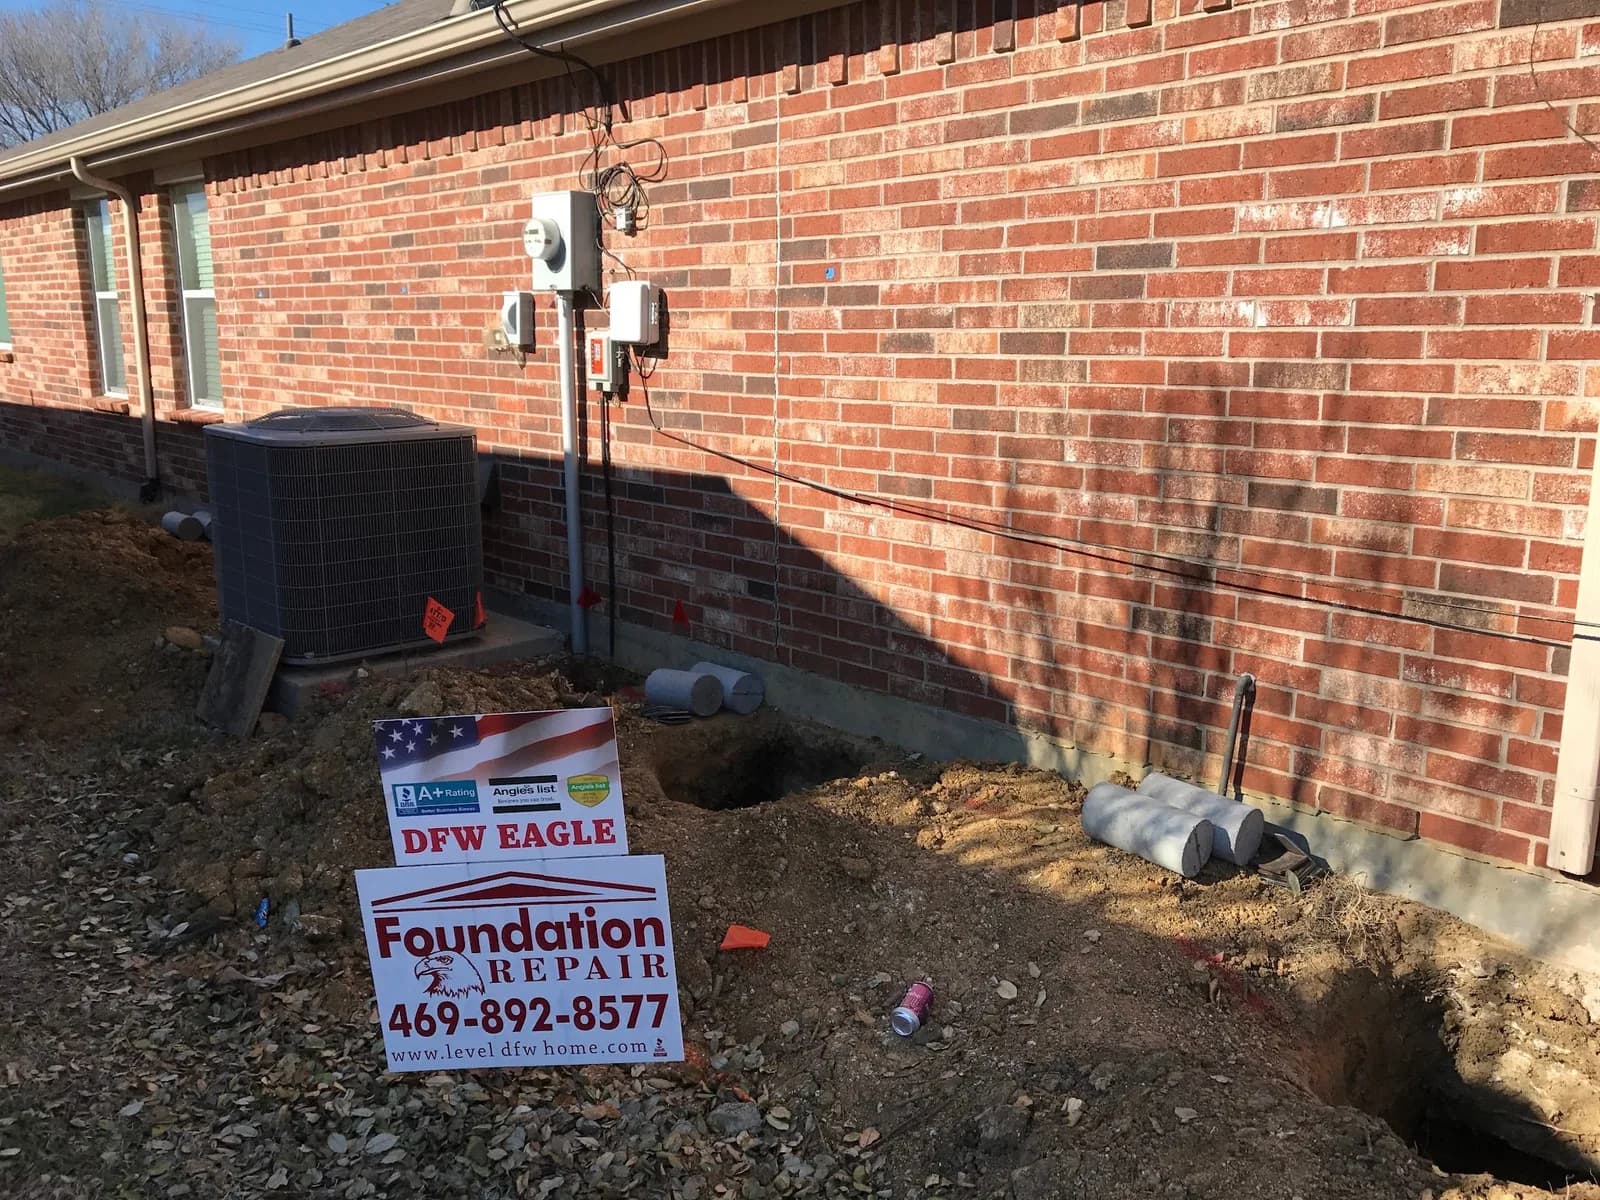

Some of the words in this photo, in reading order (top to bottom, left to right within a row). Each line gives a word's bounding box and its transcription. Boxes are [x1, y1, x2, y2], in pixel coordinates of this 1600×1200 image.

[418, 786, 444, 801] A+
[445, 788, 475, 798] Rating
[537, 784, 557, 794] list
[401, 825, 487, 854] DFW
[496, 818, 616, 849] EAGLE
[374, 906, 666, 958] Foundation
[486, 953, 669, 984] REPAIR
[389, 993, 669, 1037] 469-892-8577
